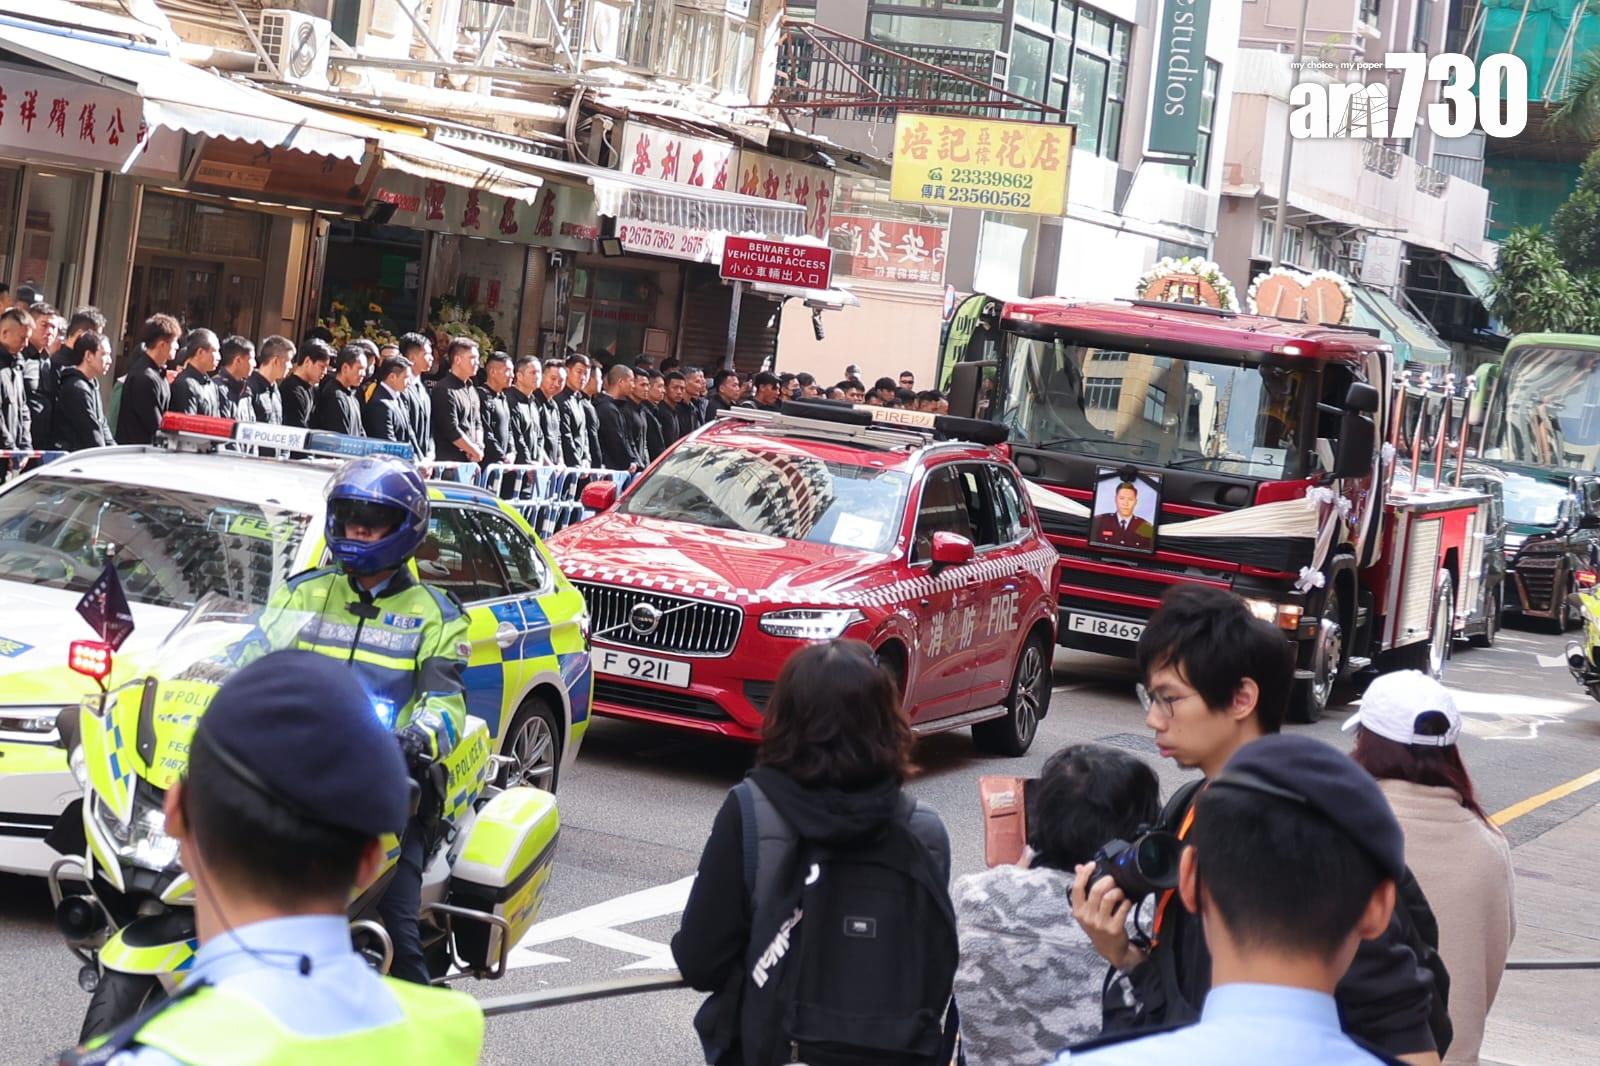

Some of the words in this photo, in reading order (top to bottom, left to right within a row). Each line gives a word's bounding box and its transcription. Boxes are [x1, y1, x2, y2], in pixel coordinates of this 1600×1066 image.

[1164, 10, 1197, 116] studios
[951, 168, 1033, 189] 23339862
[921, 184, 945, 199] 傳真
[949, 187, 1031, 208] 23560562
[628, 225, 652, 246] 2675
[652, 230, 676, 250] 7562
[681, 231, 704, 252] 2675
[748, 242, 789, 257] BEWARE
[792, 248, 807, 258] OF
[727, 251, 783, 266] VEHICULAR
[785, 257, 826, 270] ACCESS
[875, 410, 909, 425] FIRE
[255, 431, 287, 444] POLICE
[986, 591, 1020, 637] FIRE
[1075, 616, 1086, 629] F
[1092, 620, 1141, 640] 18469
[603, 652, 618, 669] F
[627, 657, 669, 681] 9211
